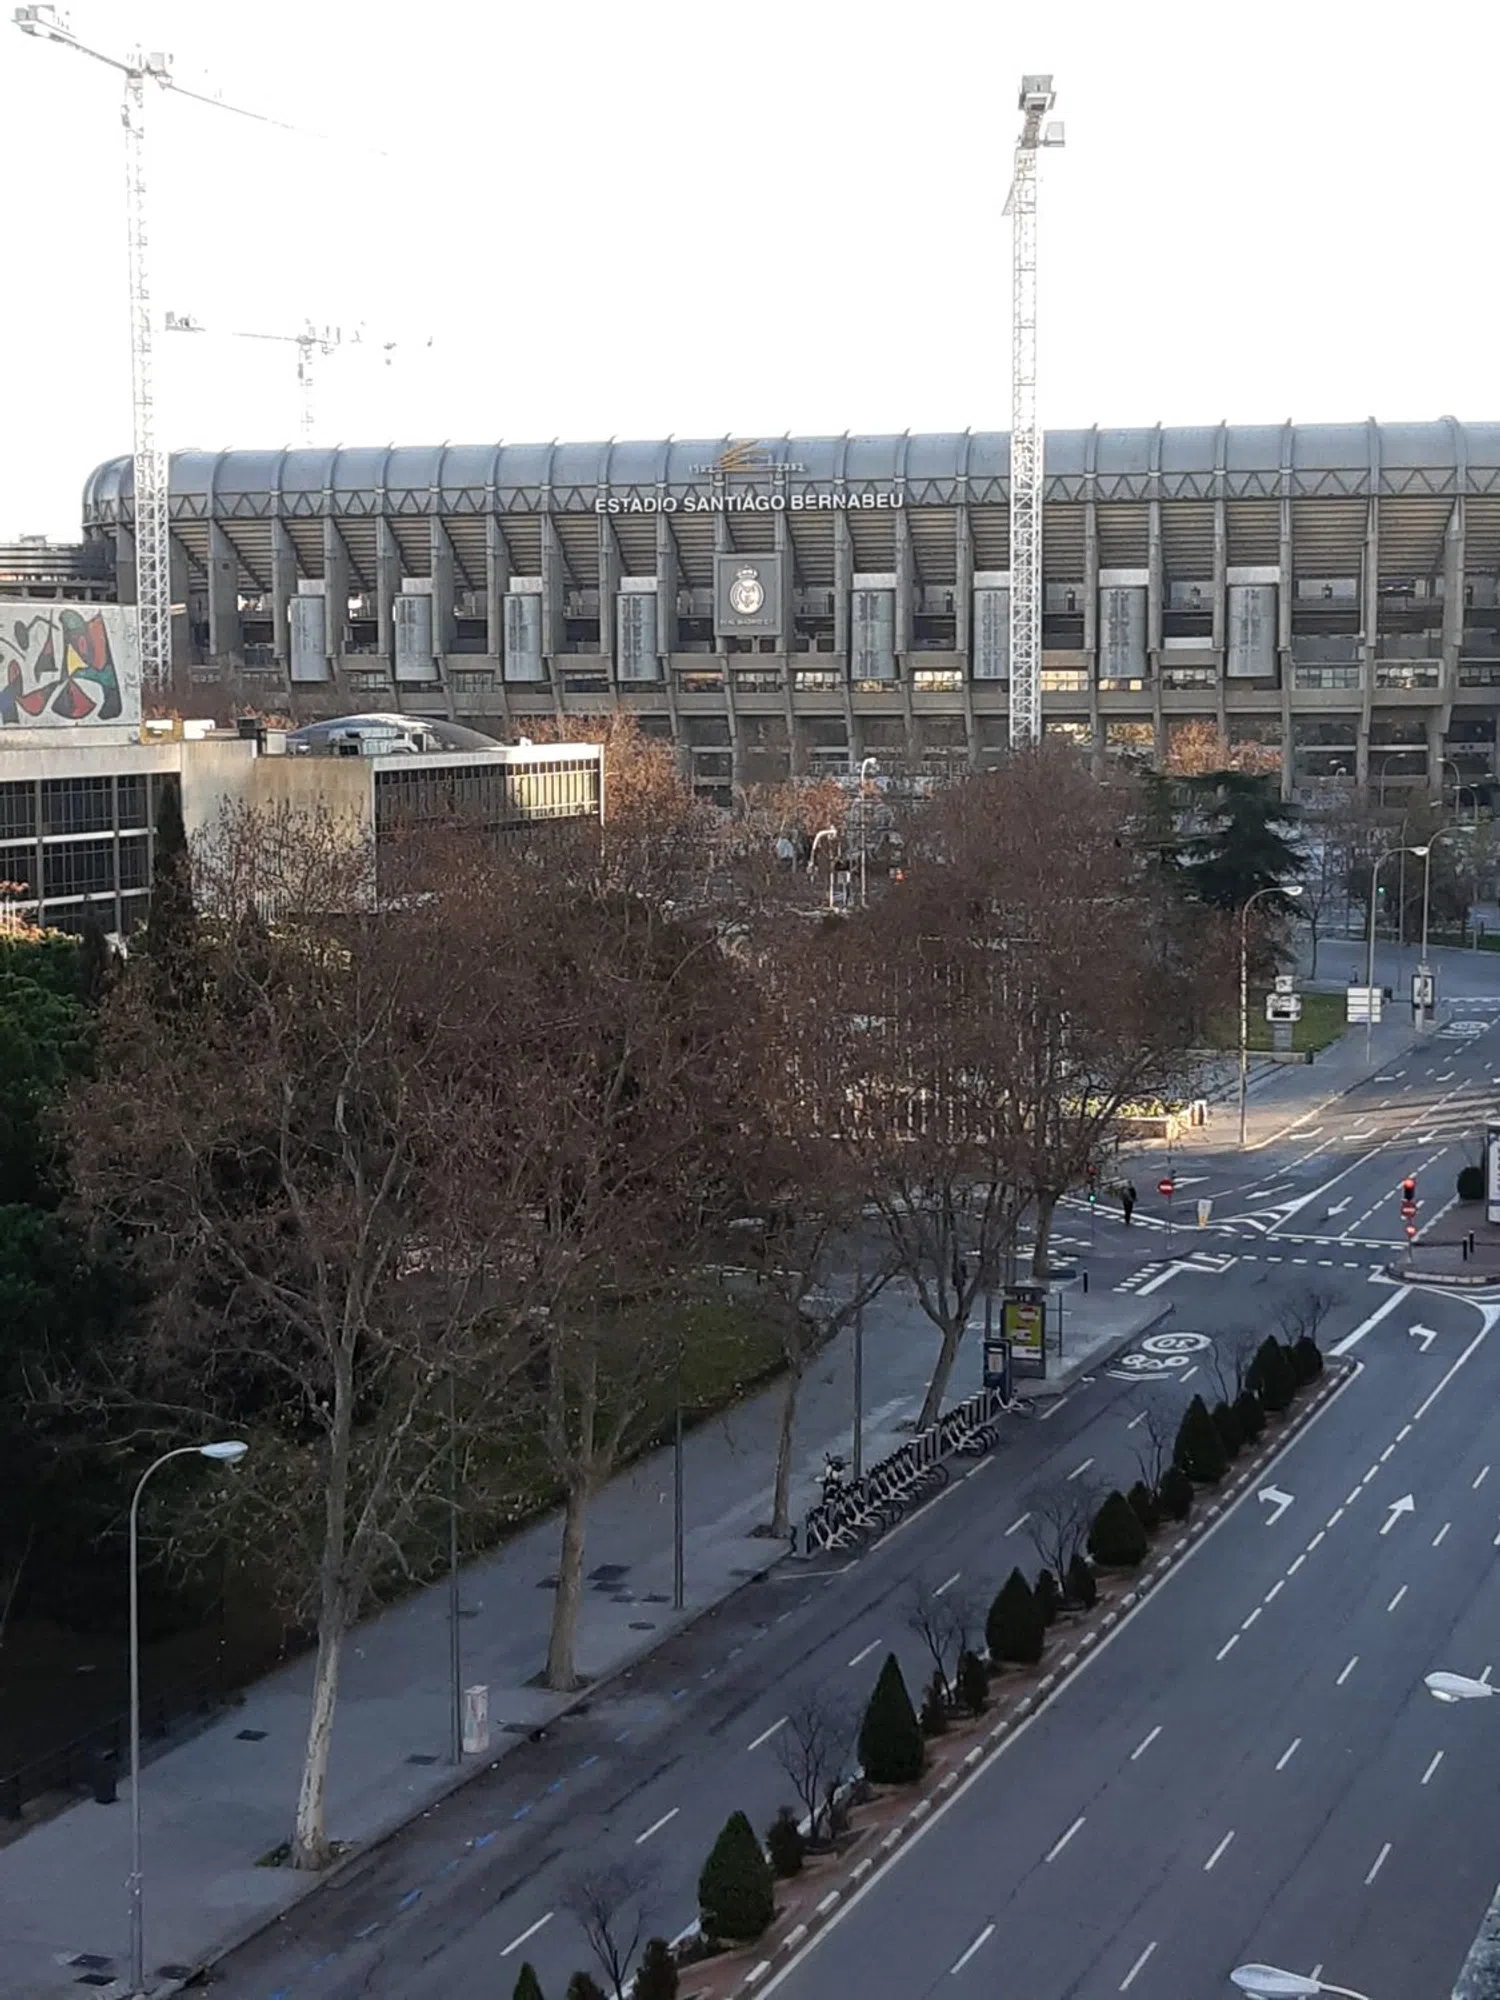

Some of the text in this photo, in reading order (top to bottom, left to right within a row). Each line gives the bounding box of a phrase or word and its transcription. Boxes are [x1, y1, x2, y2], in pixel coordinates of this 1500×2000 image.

[594, 493, 904, 514] ESTADIO SANTIAGO BERNABEU
[1157, 1338, 1196, 1349] 30
